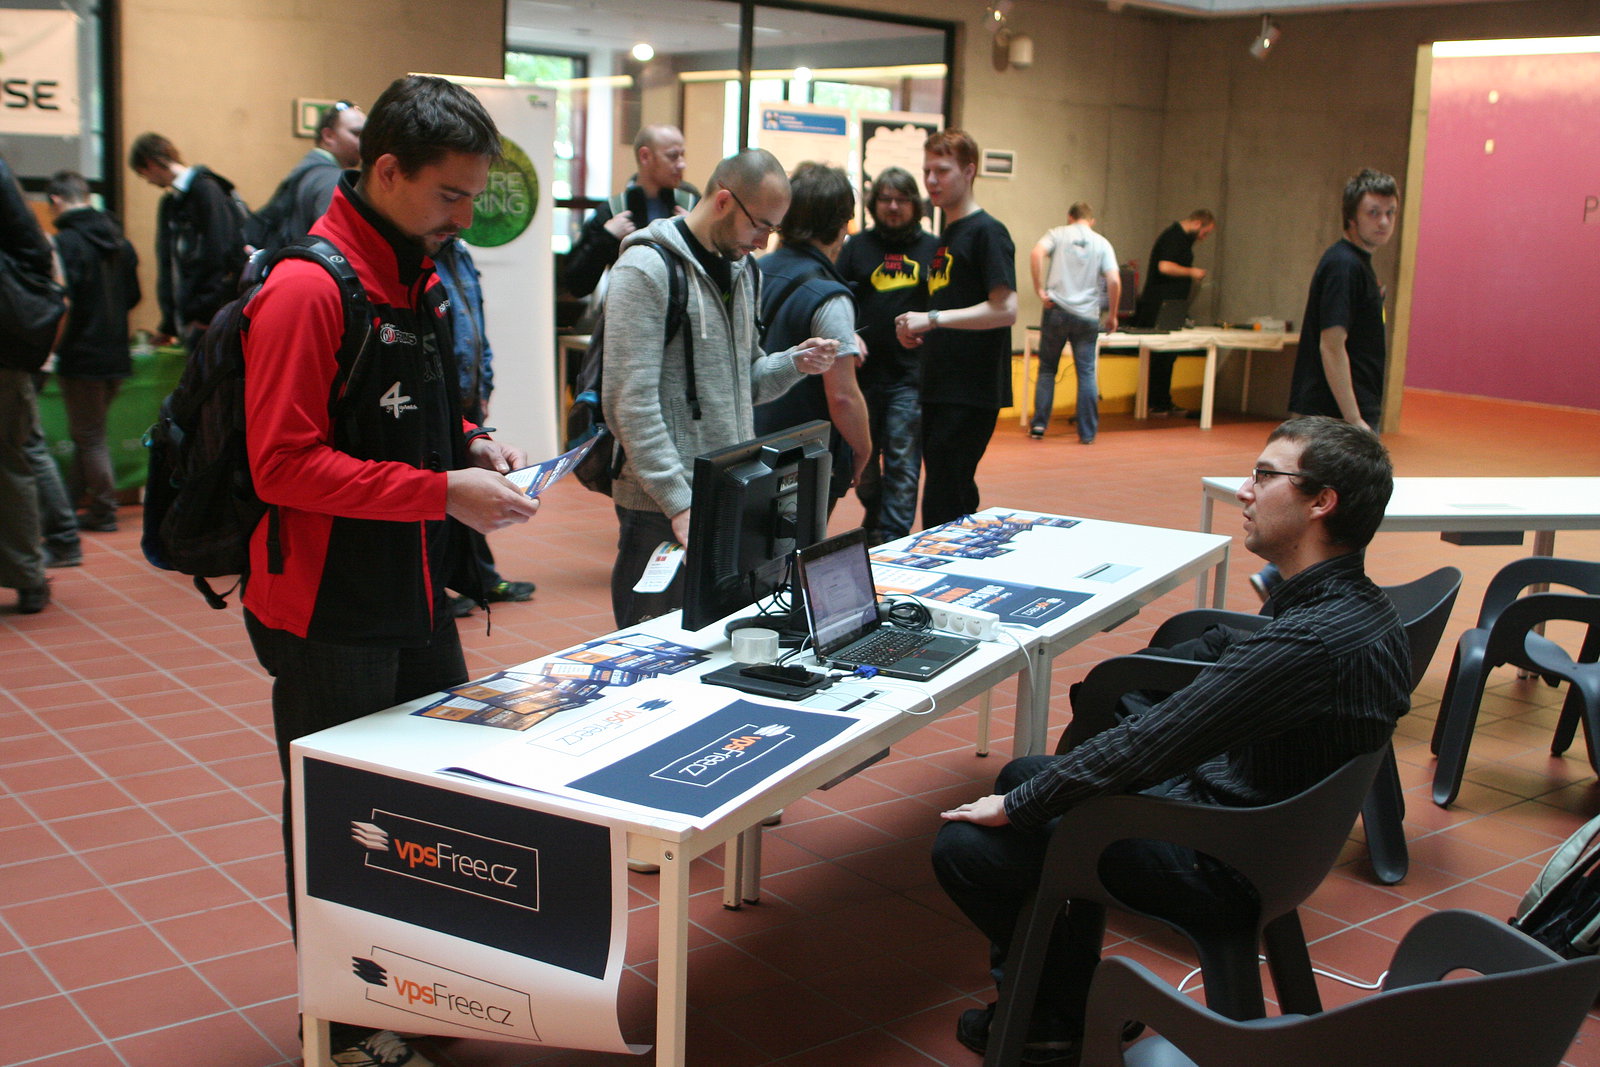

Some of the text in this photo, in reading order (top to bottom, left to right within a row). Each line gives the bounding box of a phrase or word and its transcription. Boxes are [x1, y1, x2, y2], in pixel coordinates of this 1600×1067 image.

[0, 79, 60, 110] SE
[489, 171, 524, 193] RE
[555, 709, 642, 746] vpsFree.cz
[678, 735, 762, 777] vpsFree.cz
[394, 839, 519, 888] vpsFree.cz
[394, 976, 515, 1027] vpsFree.cz
